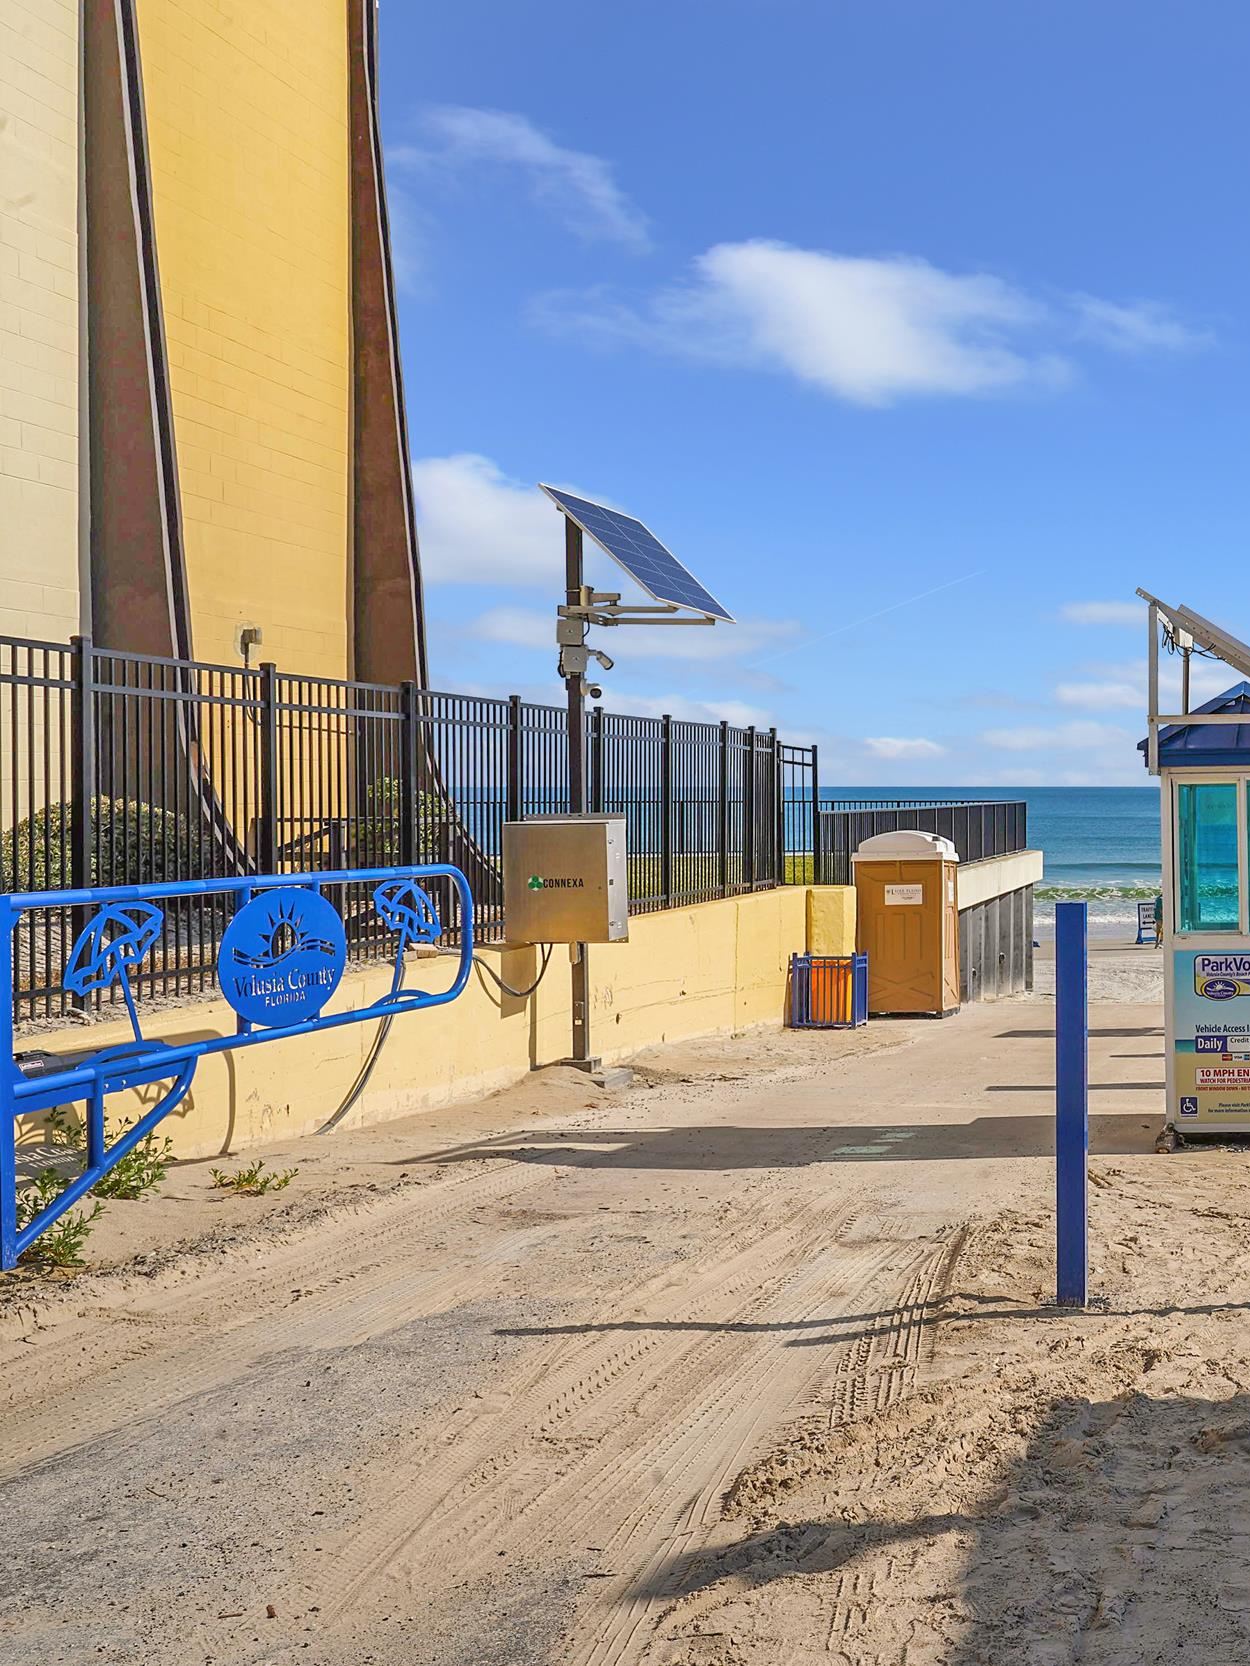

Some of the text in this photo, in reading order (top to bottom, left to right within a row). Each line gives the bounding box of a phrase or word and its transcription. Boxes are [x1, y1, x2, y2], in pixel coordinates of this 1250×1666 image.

[543, 878, 584, 889] CONNEXA
[233, 966, 335, 998] Volusia County
[265, 991, 306, 1008] FLORIDA
[1195, 1024, 1222, 1033] Vehicle
[1223, 1024, 1246, 1033] Access
[1197, 1038, 1223, 1051] Daily
[1200, 1069, 1211, 1077] 10
[1213, 1069, 1235, 1077] MPH
